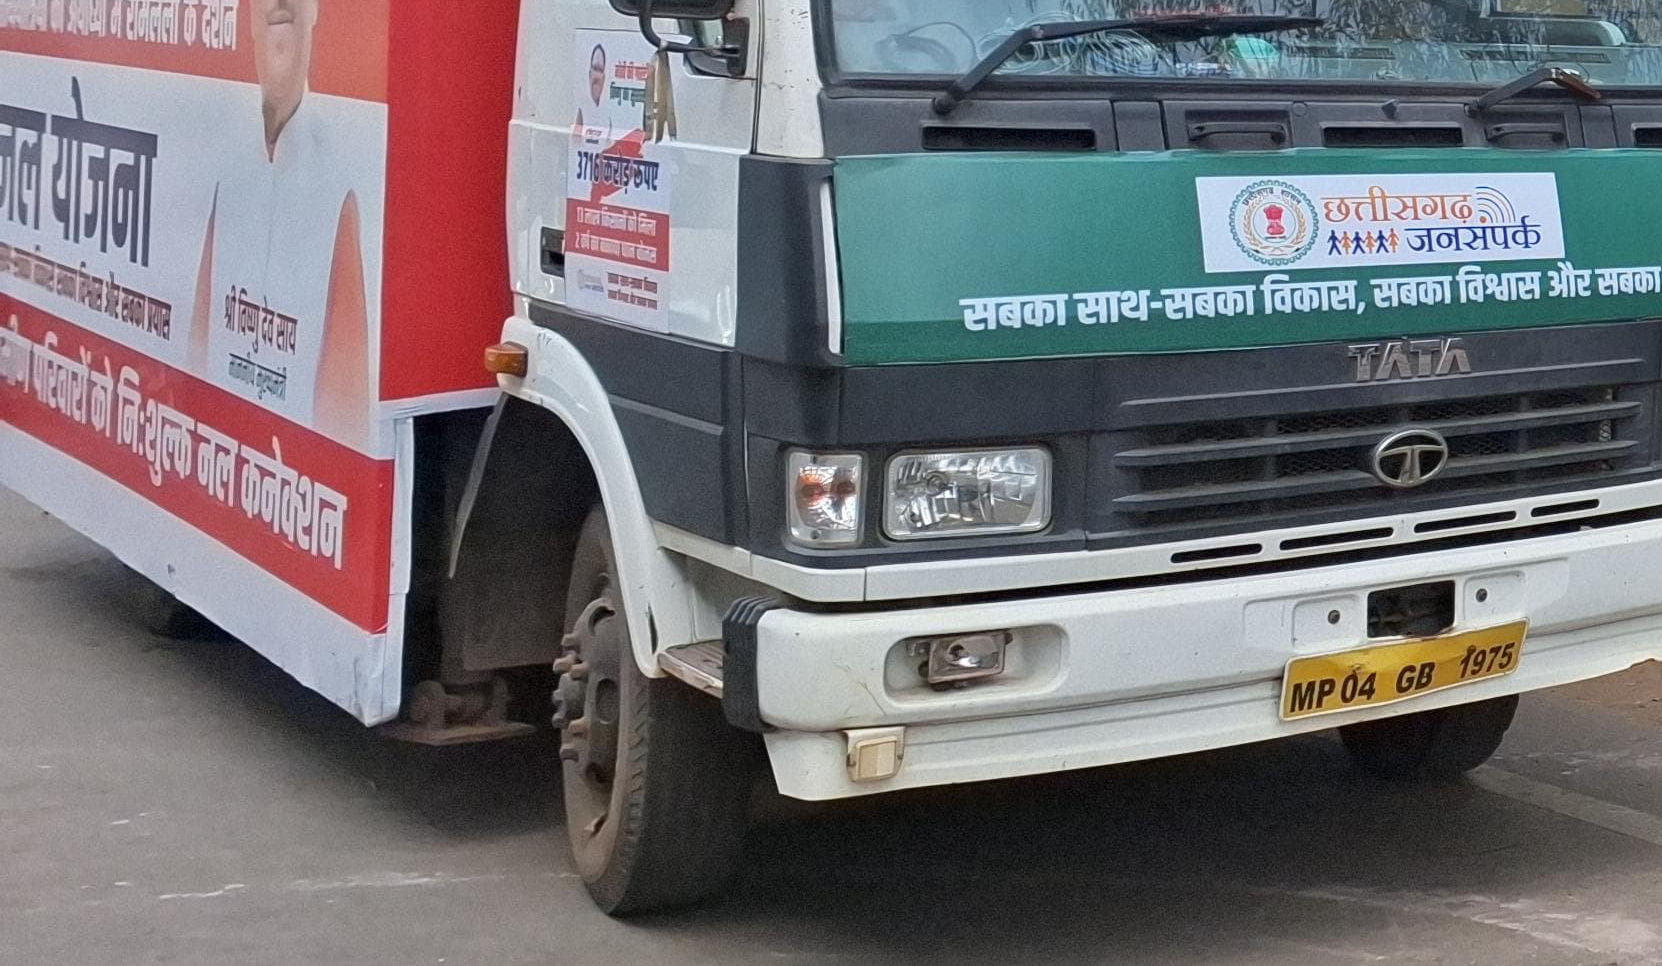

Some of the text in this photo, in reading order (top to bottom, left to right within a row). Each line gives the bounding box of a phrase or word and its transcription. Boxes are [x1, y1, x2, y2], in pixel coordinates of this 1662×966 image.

[50, 76, 158, 267] योजना
[576, 150, 600, 182] 3716
[1320, 186, 1473, 225] छत्तीसगढ़
[1403, 215, 1542, 253] जनसंपर्क
[224, 285, 298, 355] श्री विष्णु देव साय
[959, 293, 1069, 331] सबका
[1073, 284, 1256, 324] साथ-सबका
[1260, 274, 1366, 315] विकास,
[1370, 275, 1453, 308] सबका
[1456, 265, 1541, 304] विश्वास
[1548, 261, 1592, 298] और
[1595, 266, 1662, 296] सबका
[1348, 337, 1472, 382] TATA
[32, 331, 90, 424] परिवारों
[90, 356, 113, 437] को
[197, 421, 240, 508] नल
[240, 435, 348, 570] कनेक्शन
[1289, 677, 1336, 713] MP
[1395, 661, 1436, 694] GB
[1460, 642, 1516, 679] 1975
